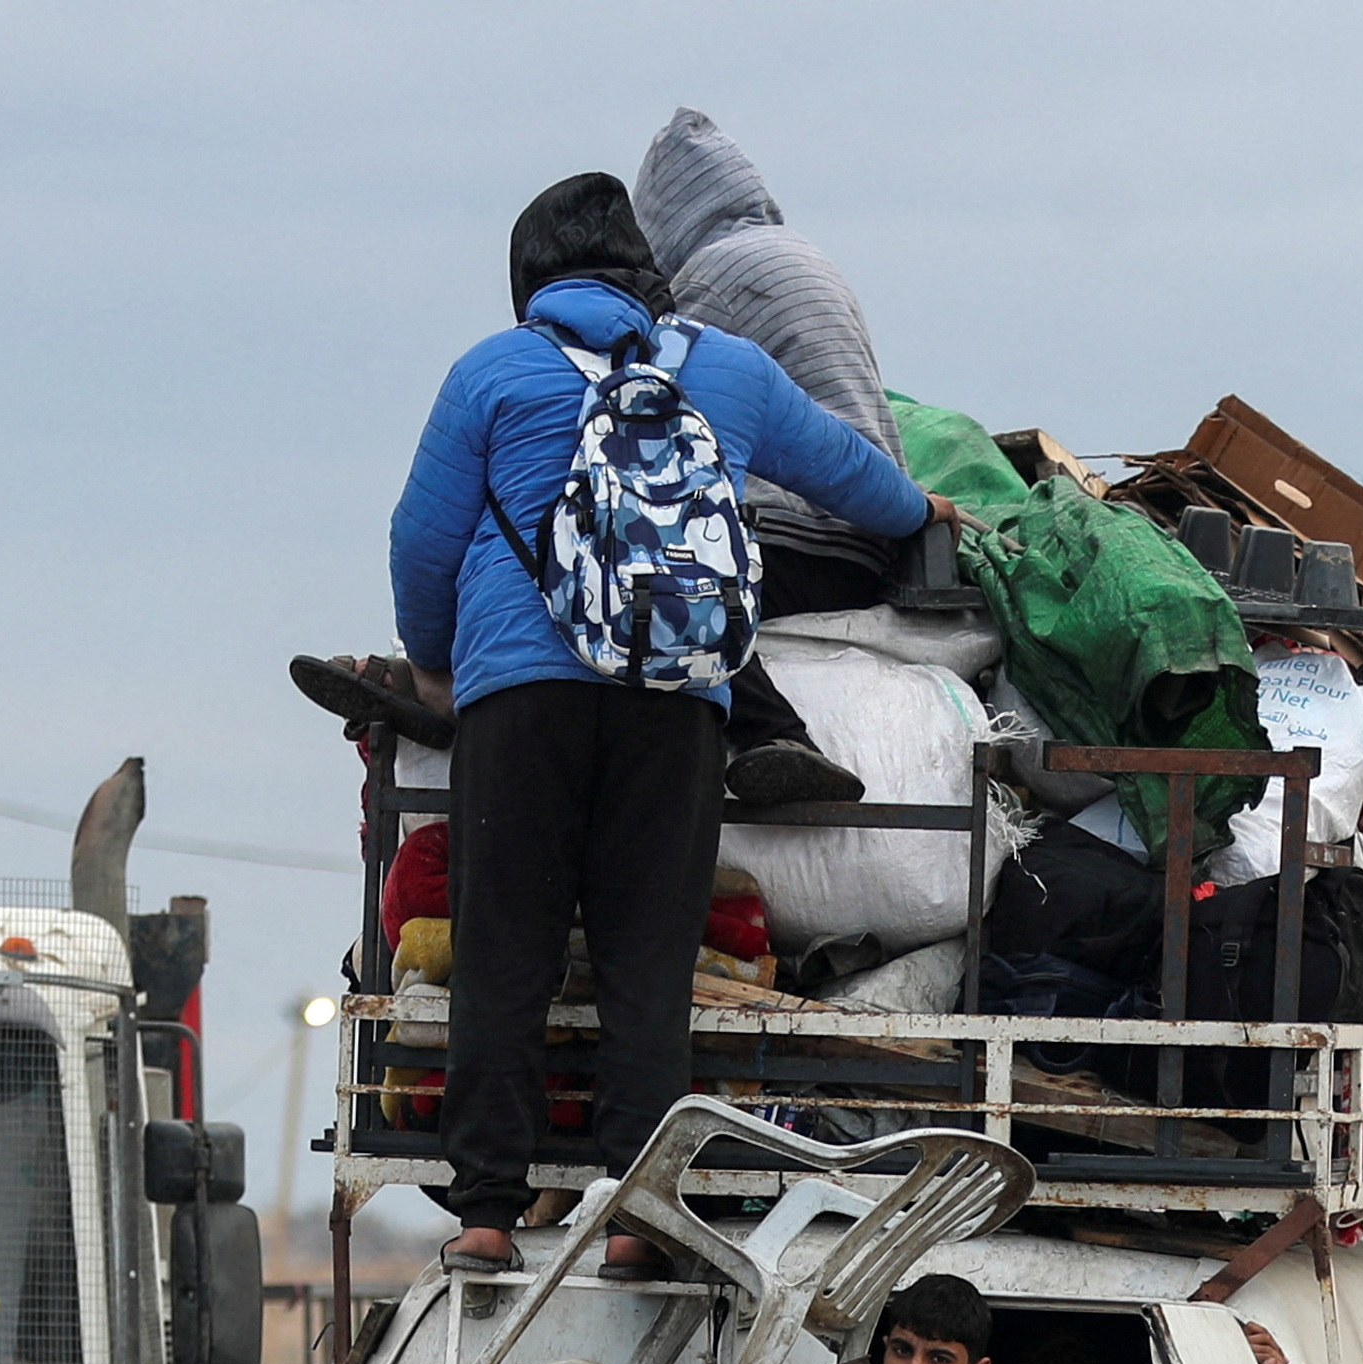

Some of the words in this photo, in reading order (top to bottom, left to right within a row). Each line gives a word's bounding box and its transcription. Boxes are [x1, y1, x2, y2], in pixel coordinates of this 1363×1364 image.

[664, 550, 693, 559] FASHION
[1260, 675, 1293, 688] eat
[1297, 677, 1350, 701] Flour
[1272, 687, 1311, 709] Net
